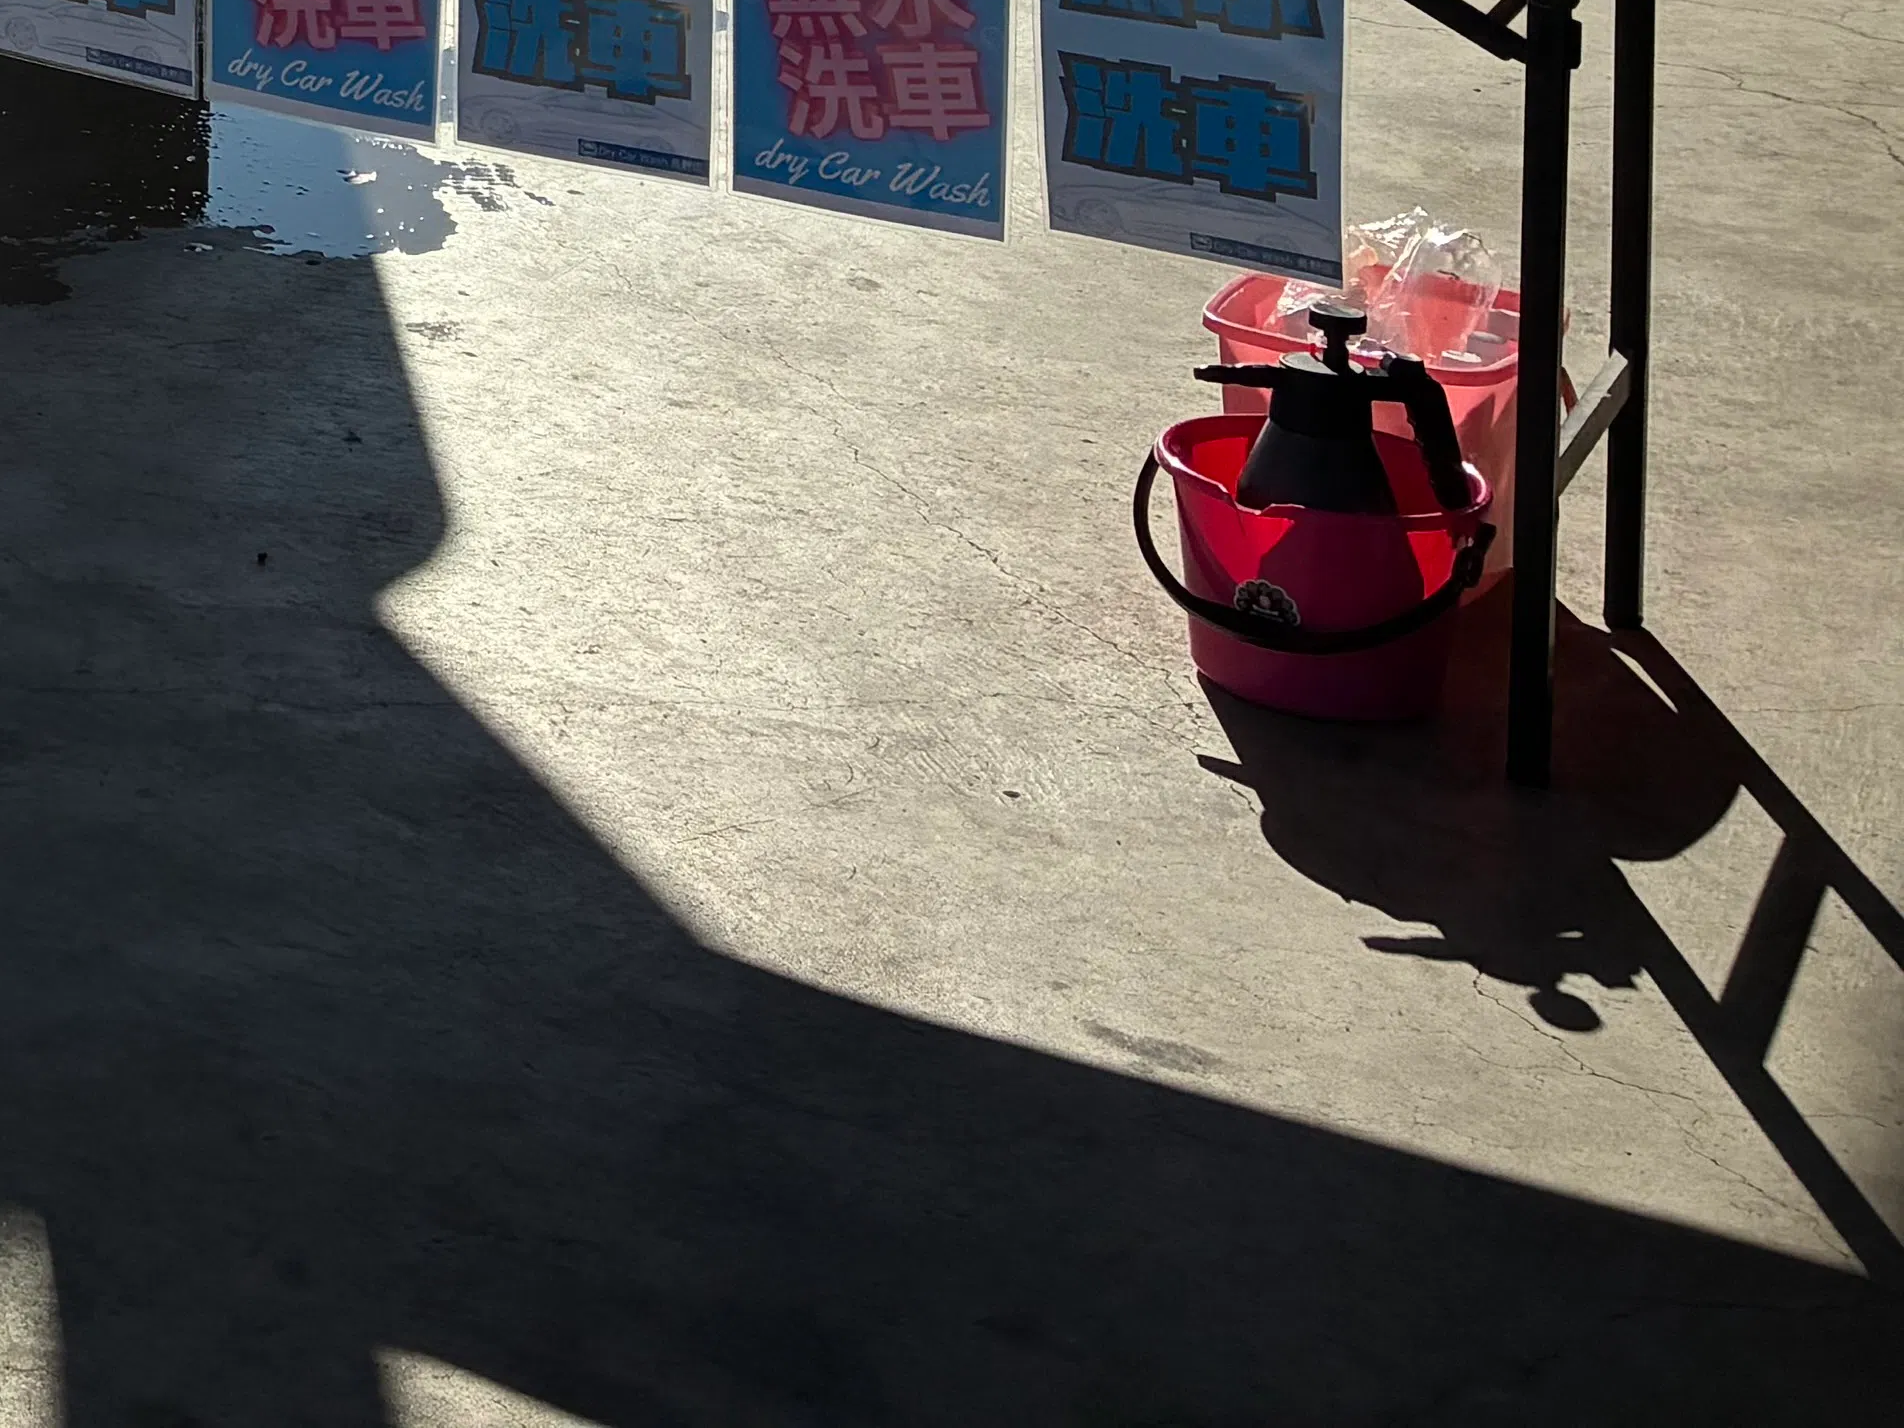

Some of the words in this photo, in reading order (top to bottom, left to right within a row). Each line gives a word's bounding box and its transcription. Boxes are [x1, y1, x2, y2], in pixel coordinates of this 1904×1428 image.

[227, 48, 277, 91] dry
[280, 60, 333, 92] Car
[339, 70, 426, 112] Wash
[776, 42, 990, 141] 洗車
[1057, 50, 1318, 203] 洗車
[754, 138, 810, 184] dry
[817, 151, 881, 188] Car
[889, 162, 991, 209] Wash
